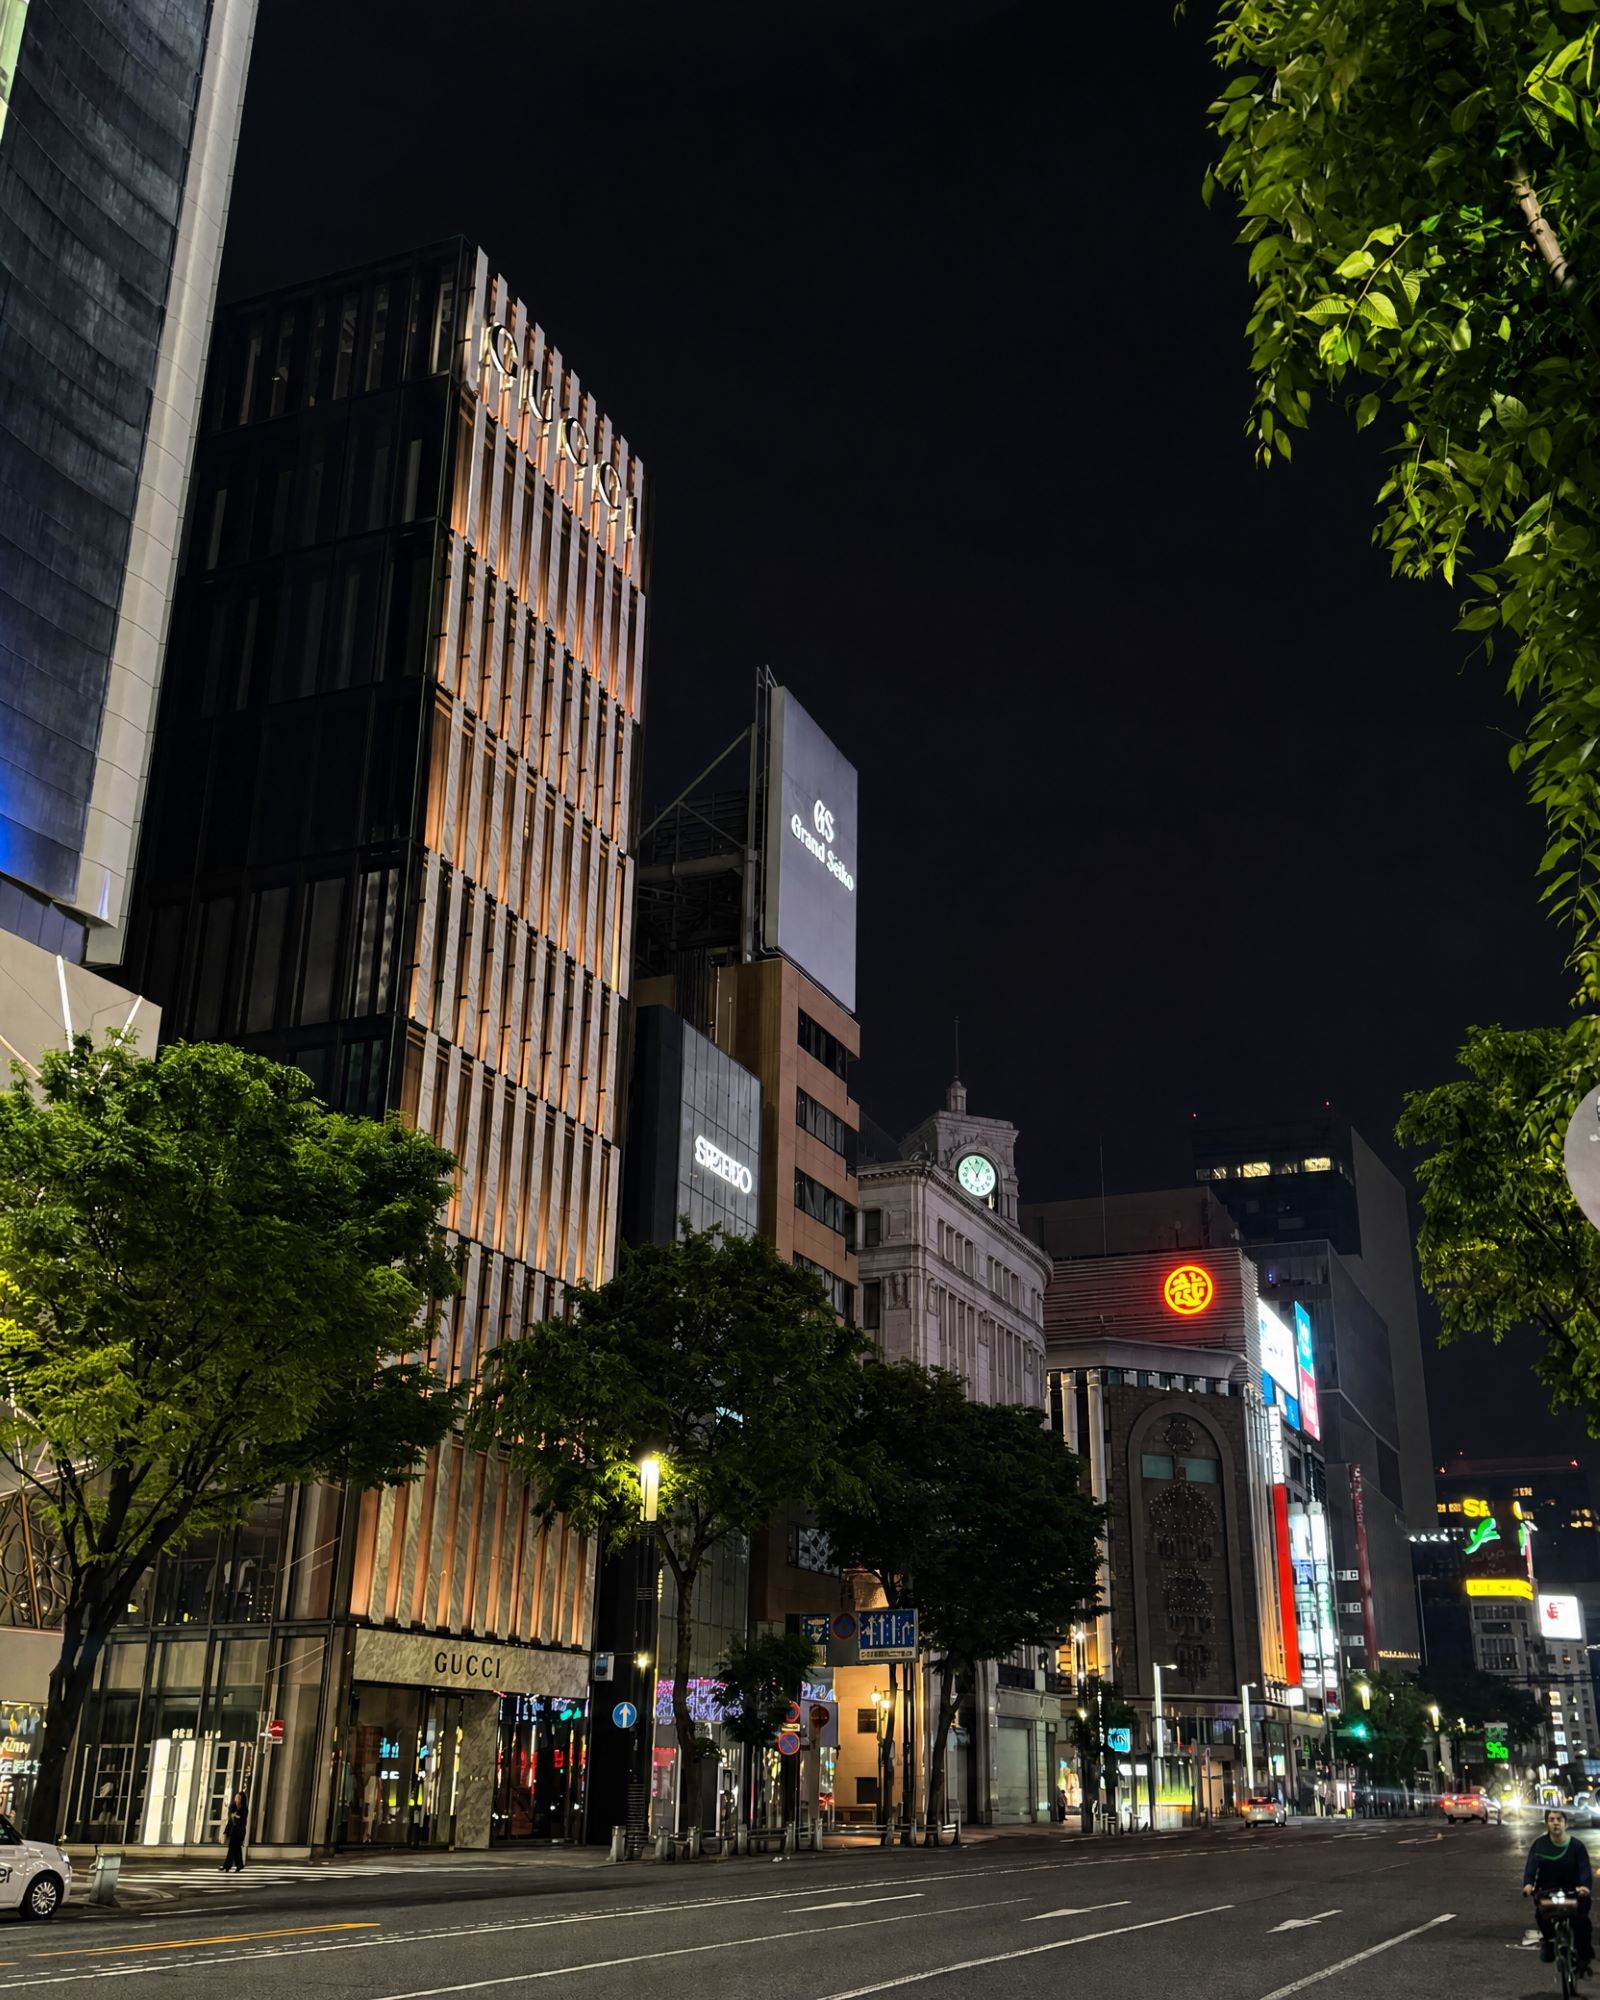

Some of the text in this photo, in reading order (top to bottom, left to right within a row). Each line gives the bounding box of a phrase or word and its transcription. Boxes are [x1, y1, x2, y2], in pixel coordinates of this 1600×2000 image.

[791, 813, 854, 892] Grand Seiko
[434, 1651, 501, 1679] GUCCI
